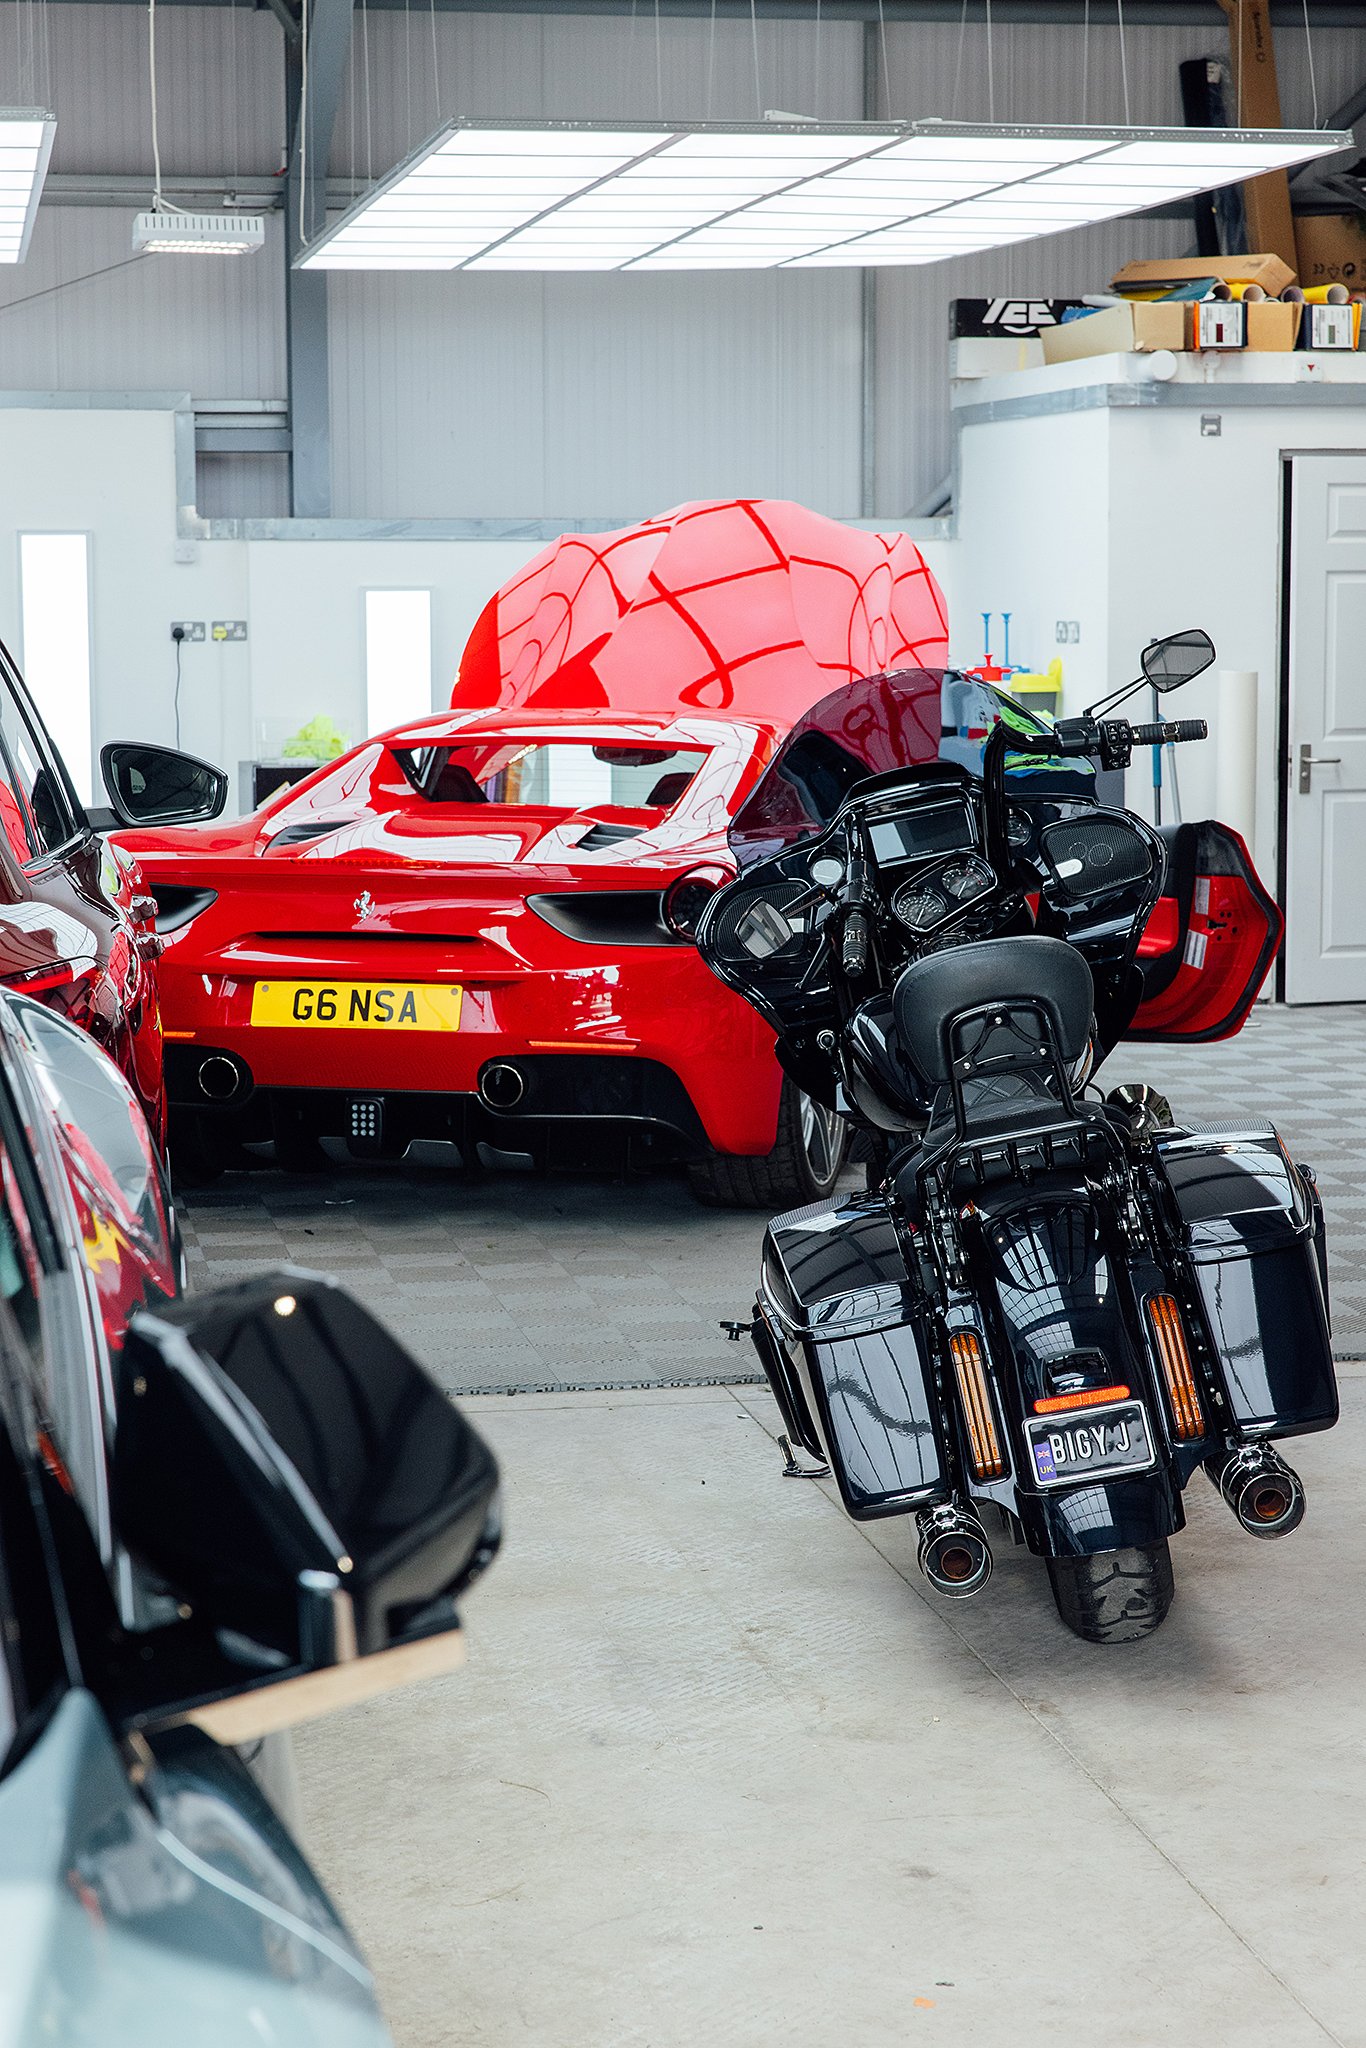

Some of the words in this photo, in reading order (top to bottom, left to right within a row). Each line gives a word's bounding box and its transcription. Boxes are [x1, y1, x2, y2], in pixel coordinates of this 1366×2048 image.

[292, 988, 337, 1021] G6
[349, 989, 417, 1023] NSA
[1048, 1424, 1108, 1464] BIGY
[1116, 1420, 1131, 1452] J
[1040, 1465, 1054, 1475] UK
